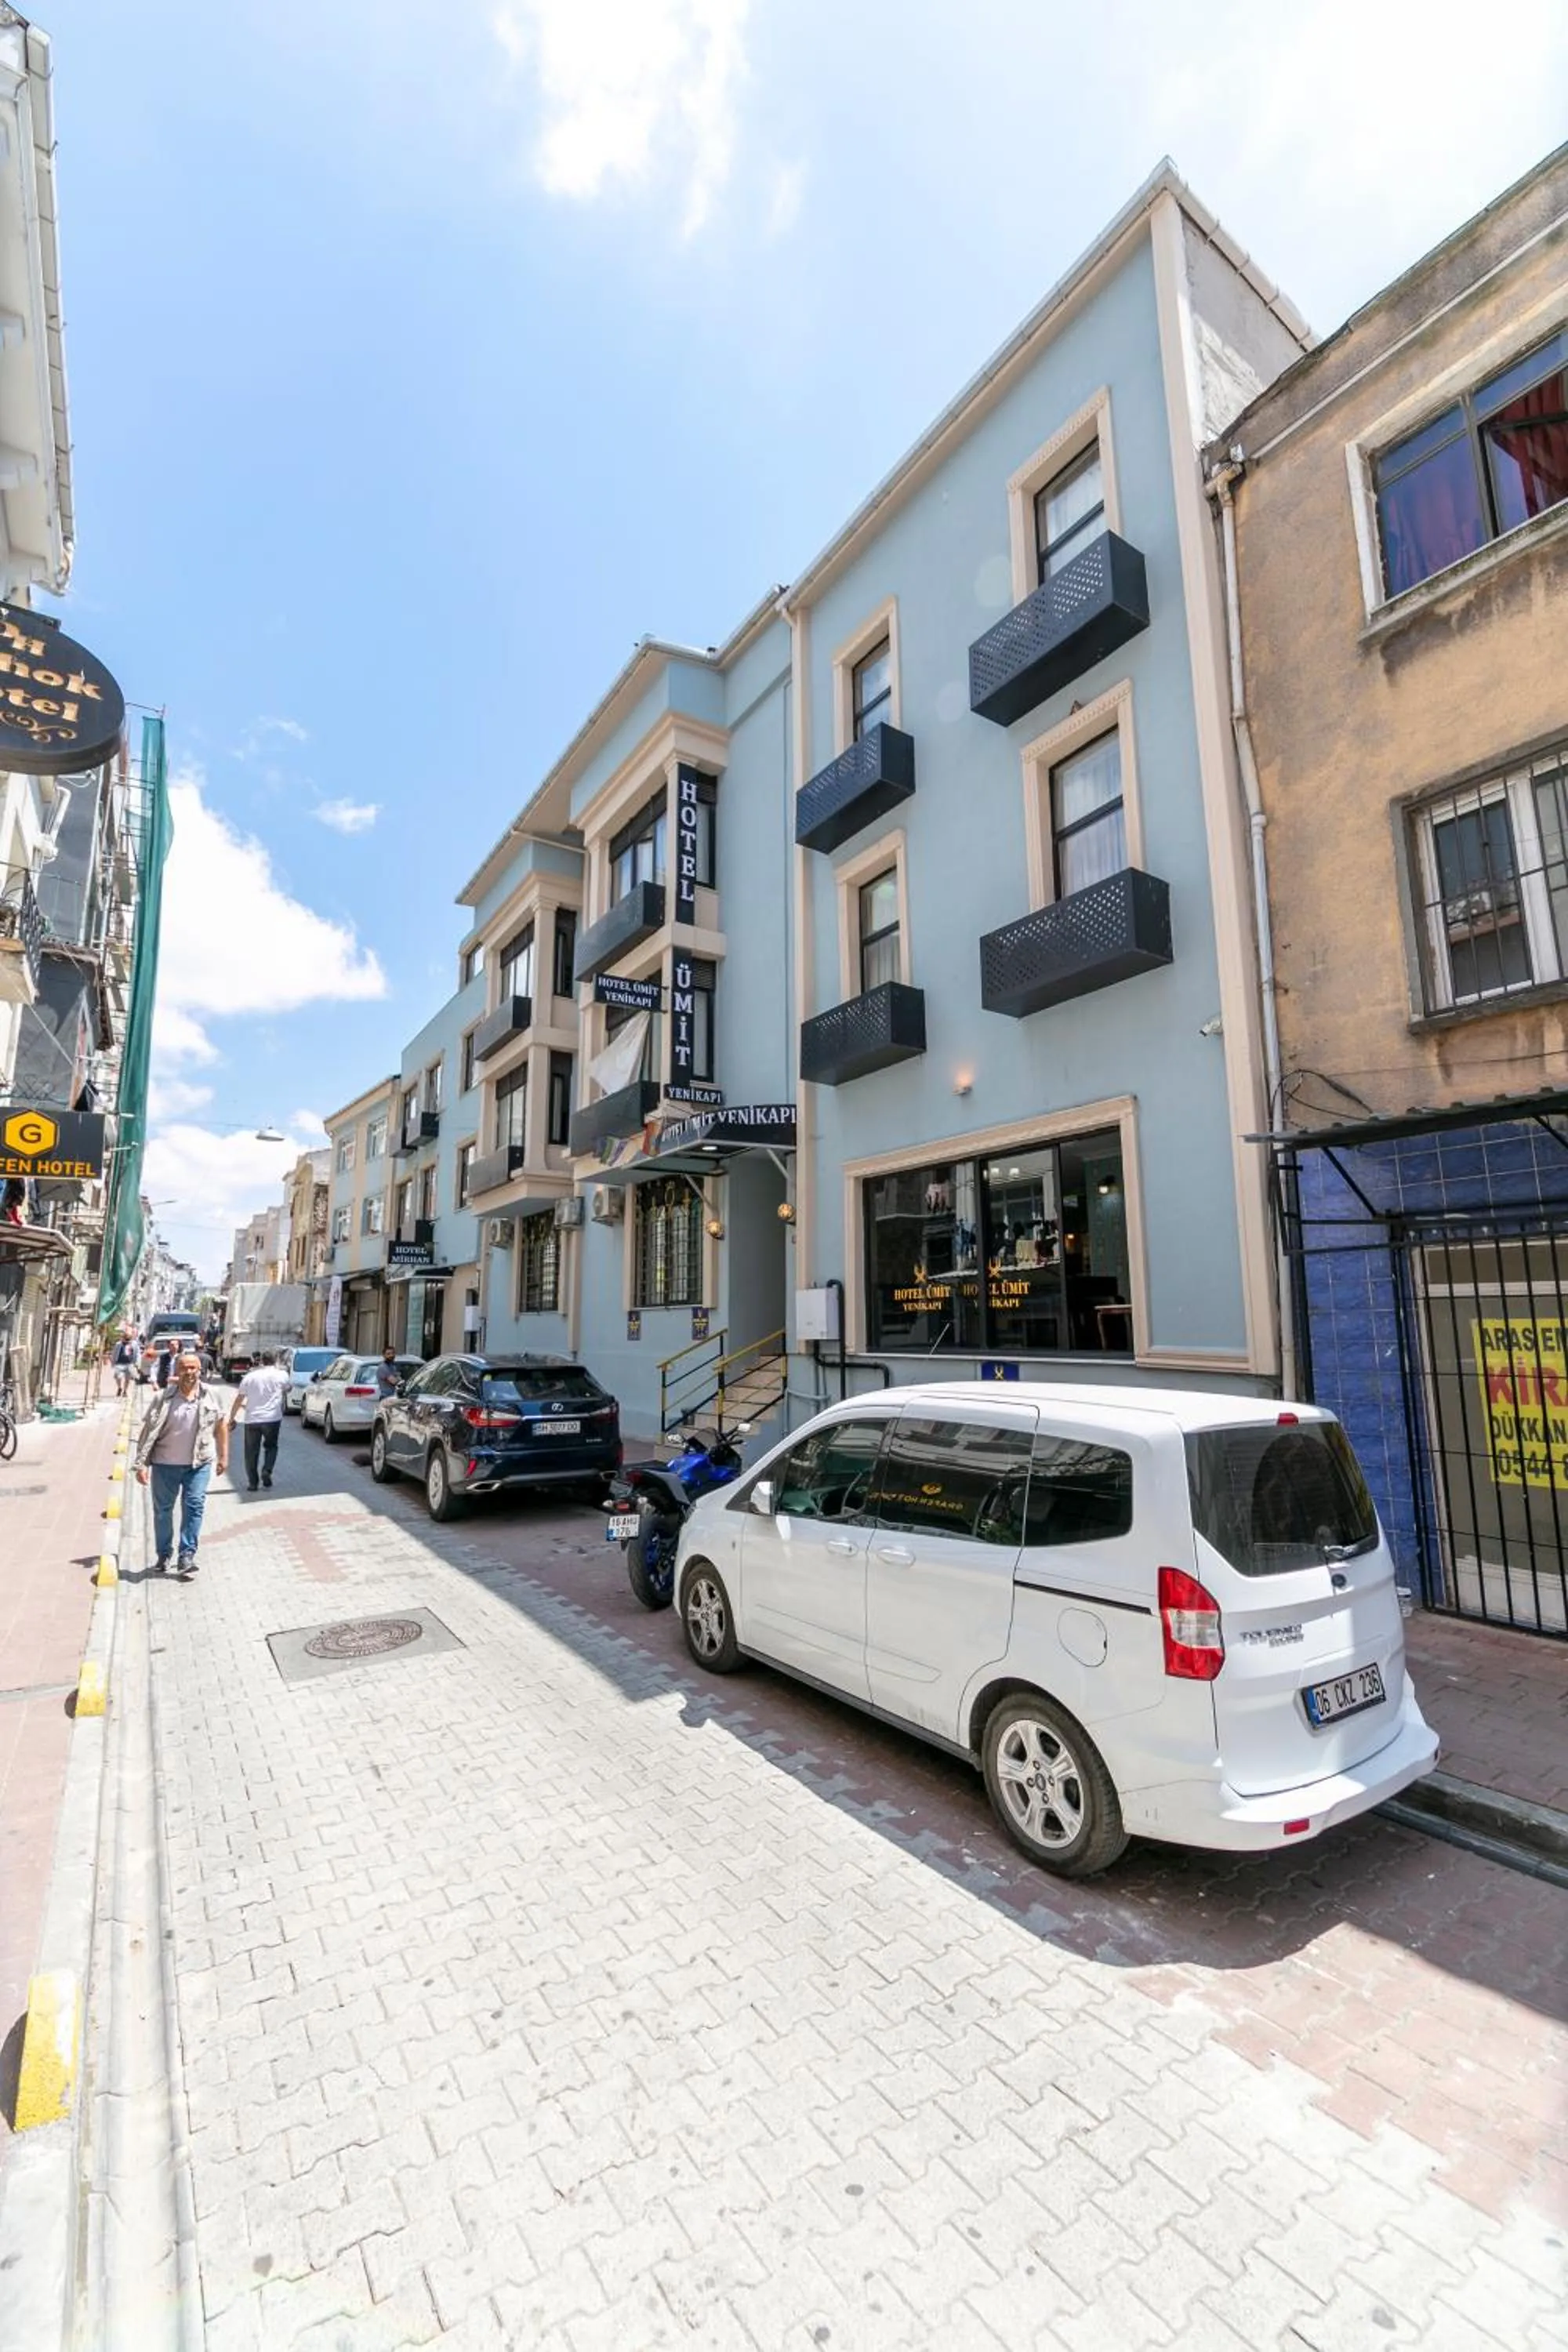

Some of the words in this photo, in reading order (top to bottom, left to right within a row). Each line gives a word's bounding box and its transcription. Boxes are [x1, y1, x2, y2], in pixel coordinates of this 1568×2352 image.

[0, 687, 78, 723] tel
[681, 781, 697, 902] HOTEL
[598, 976, 631, 992] HOTEL
[604, 990, 652, 1007] YENİKAPI
[674, 963, 693, 1066] ÜMİT
[668, 1087, 721, 1103] YENİKAPI
[717, 1105, 797, 1126] YENİKAPI
[19, 1123, 42, 1144] G
[37, 1160, 96, 1178] HOTEL
[395, 1246, 427, 1254] HOTEL
[894, 1288, 924, 1301] HOTEL
[1486, 1356, 1568, 1408] KİR
[1316, 1688, 1331, 1716] 06
[1334, 1679, 1357, 1708] CKZ
[1359, 1669, 1381, 1698] 236
